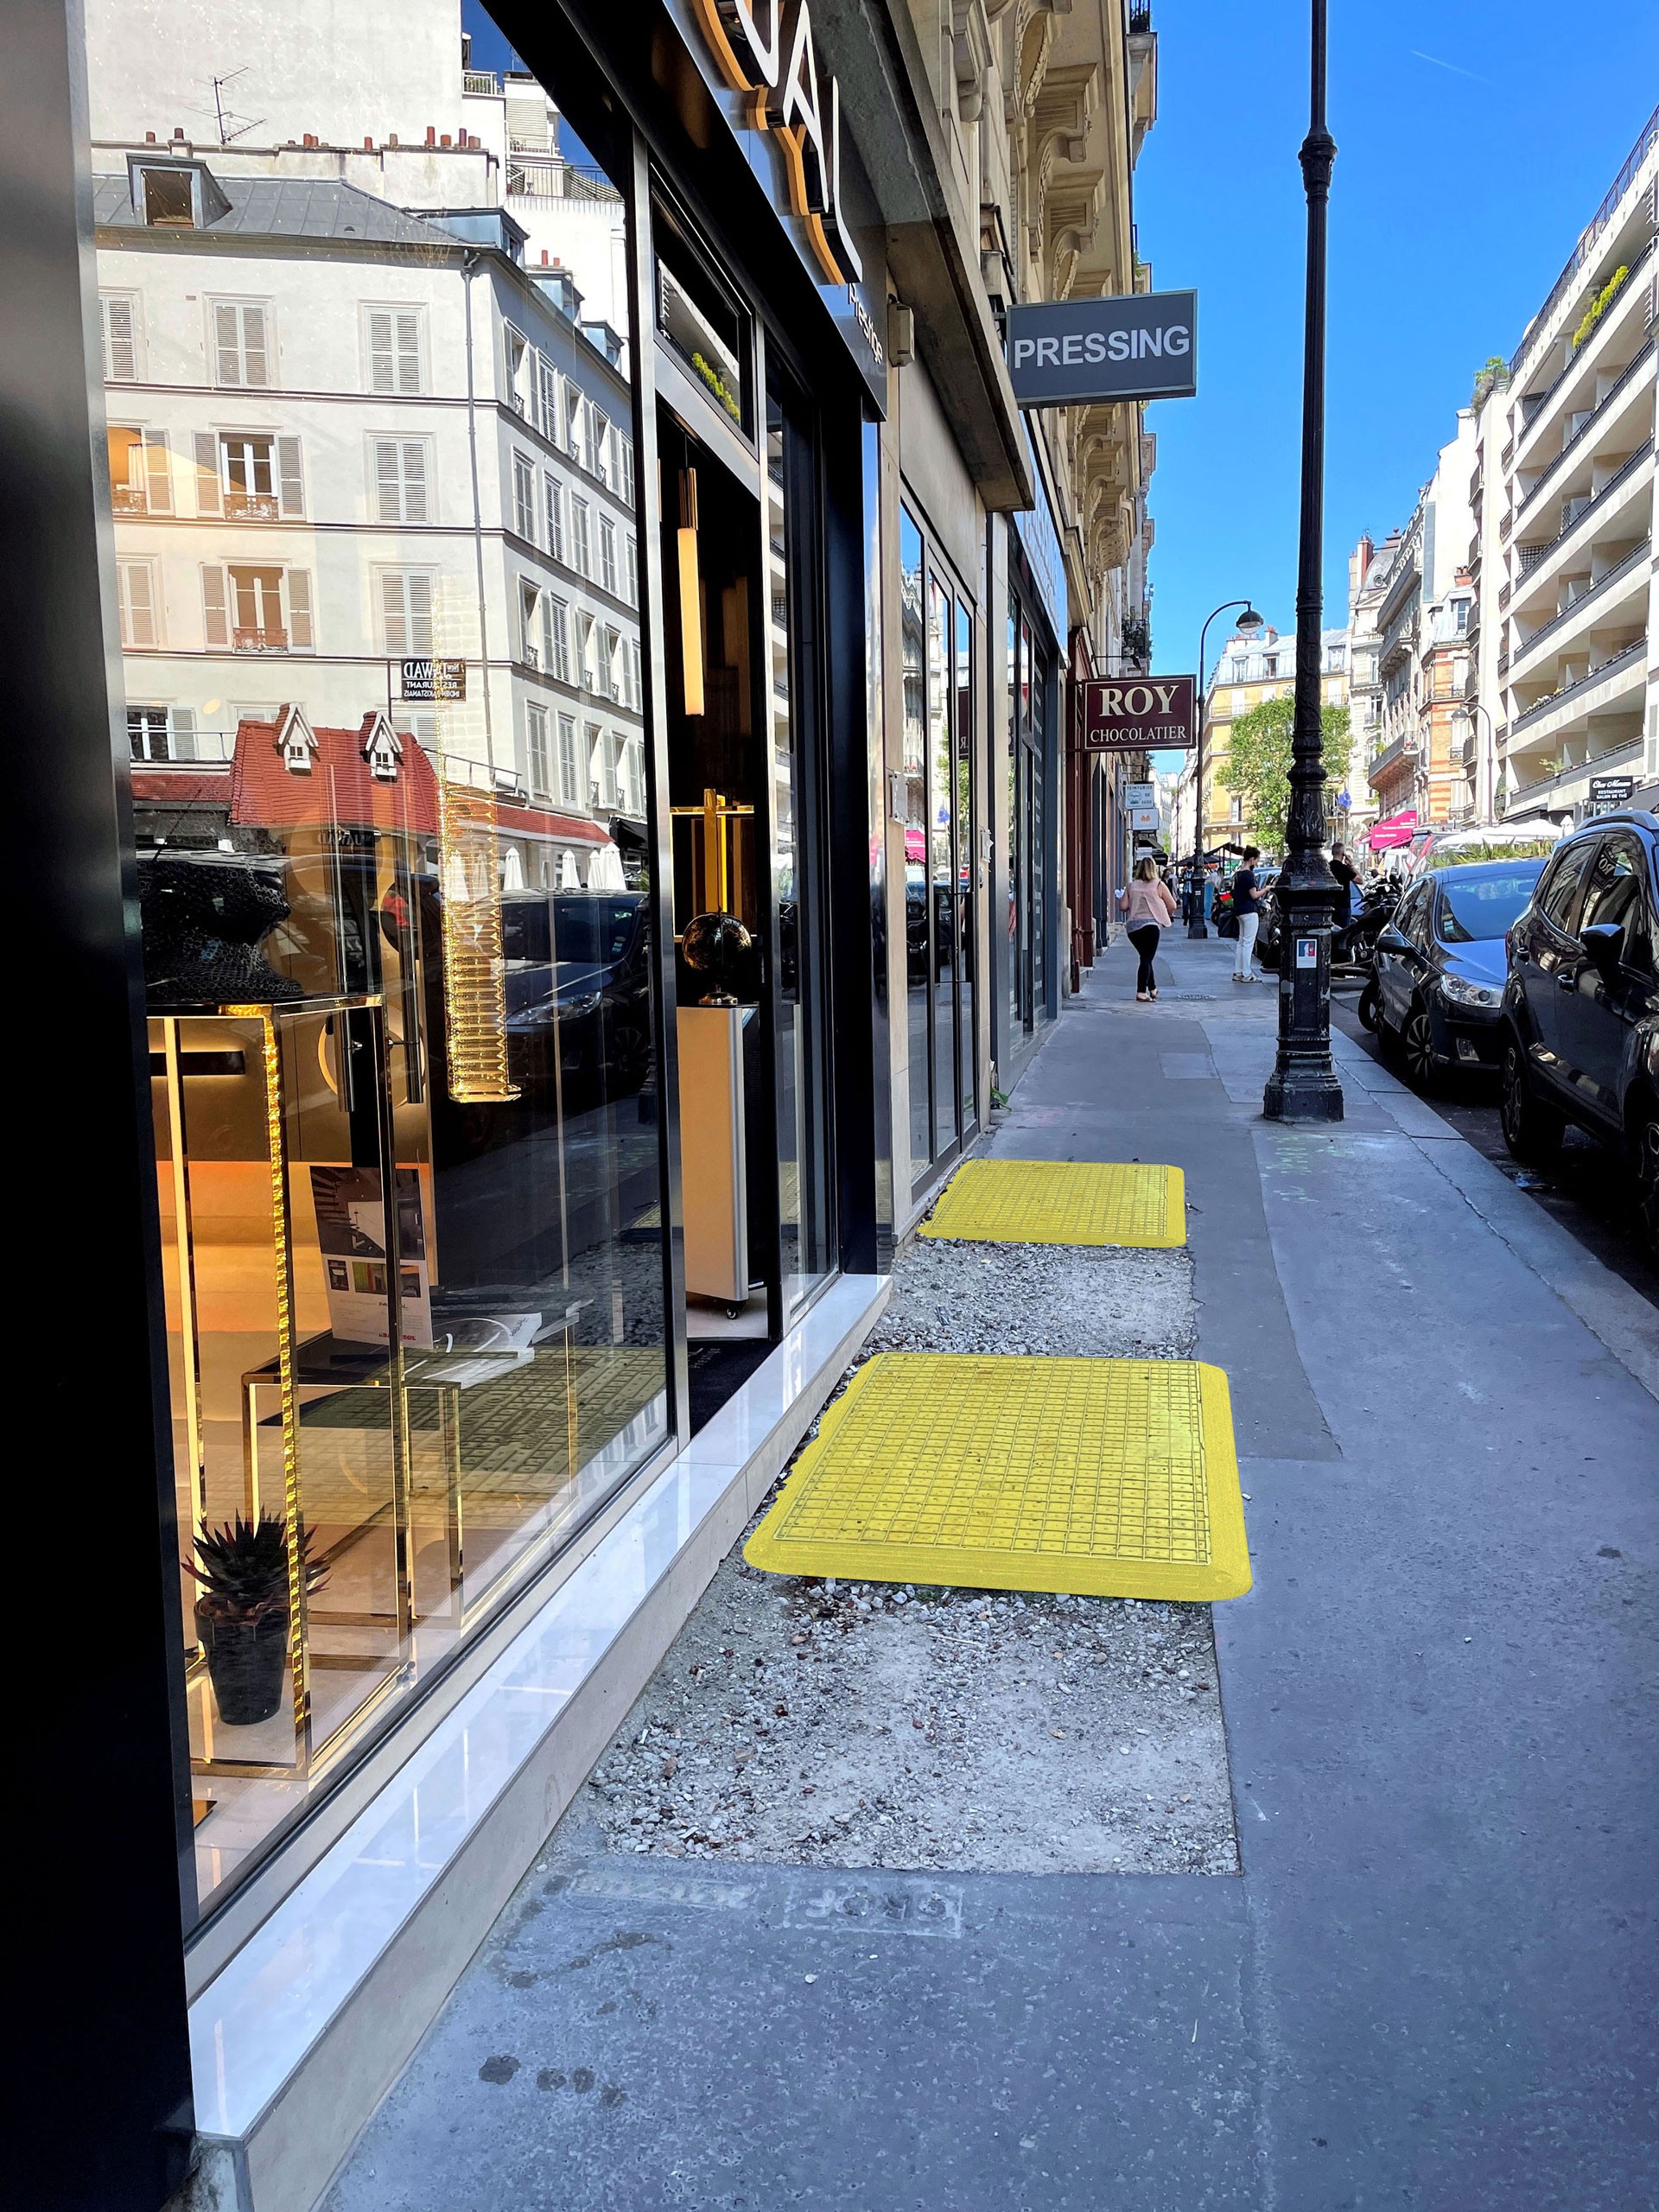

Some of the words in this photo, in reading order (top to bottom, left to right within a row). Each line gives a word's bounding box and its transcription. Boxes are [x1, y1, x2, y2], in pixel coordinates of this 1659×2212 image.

[849, 283, 883, 365] Prestige
[1014, 325, 1190, 369] PRESSING
[1099, 685, 1179, 716] ROY
[1090, 726, 1186, 742] CHOCOLATIER
